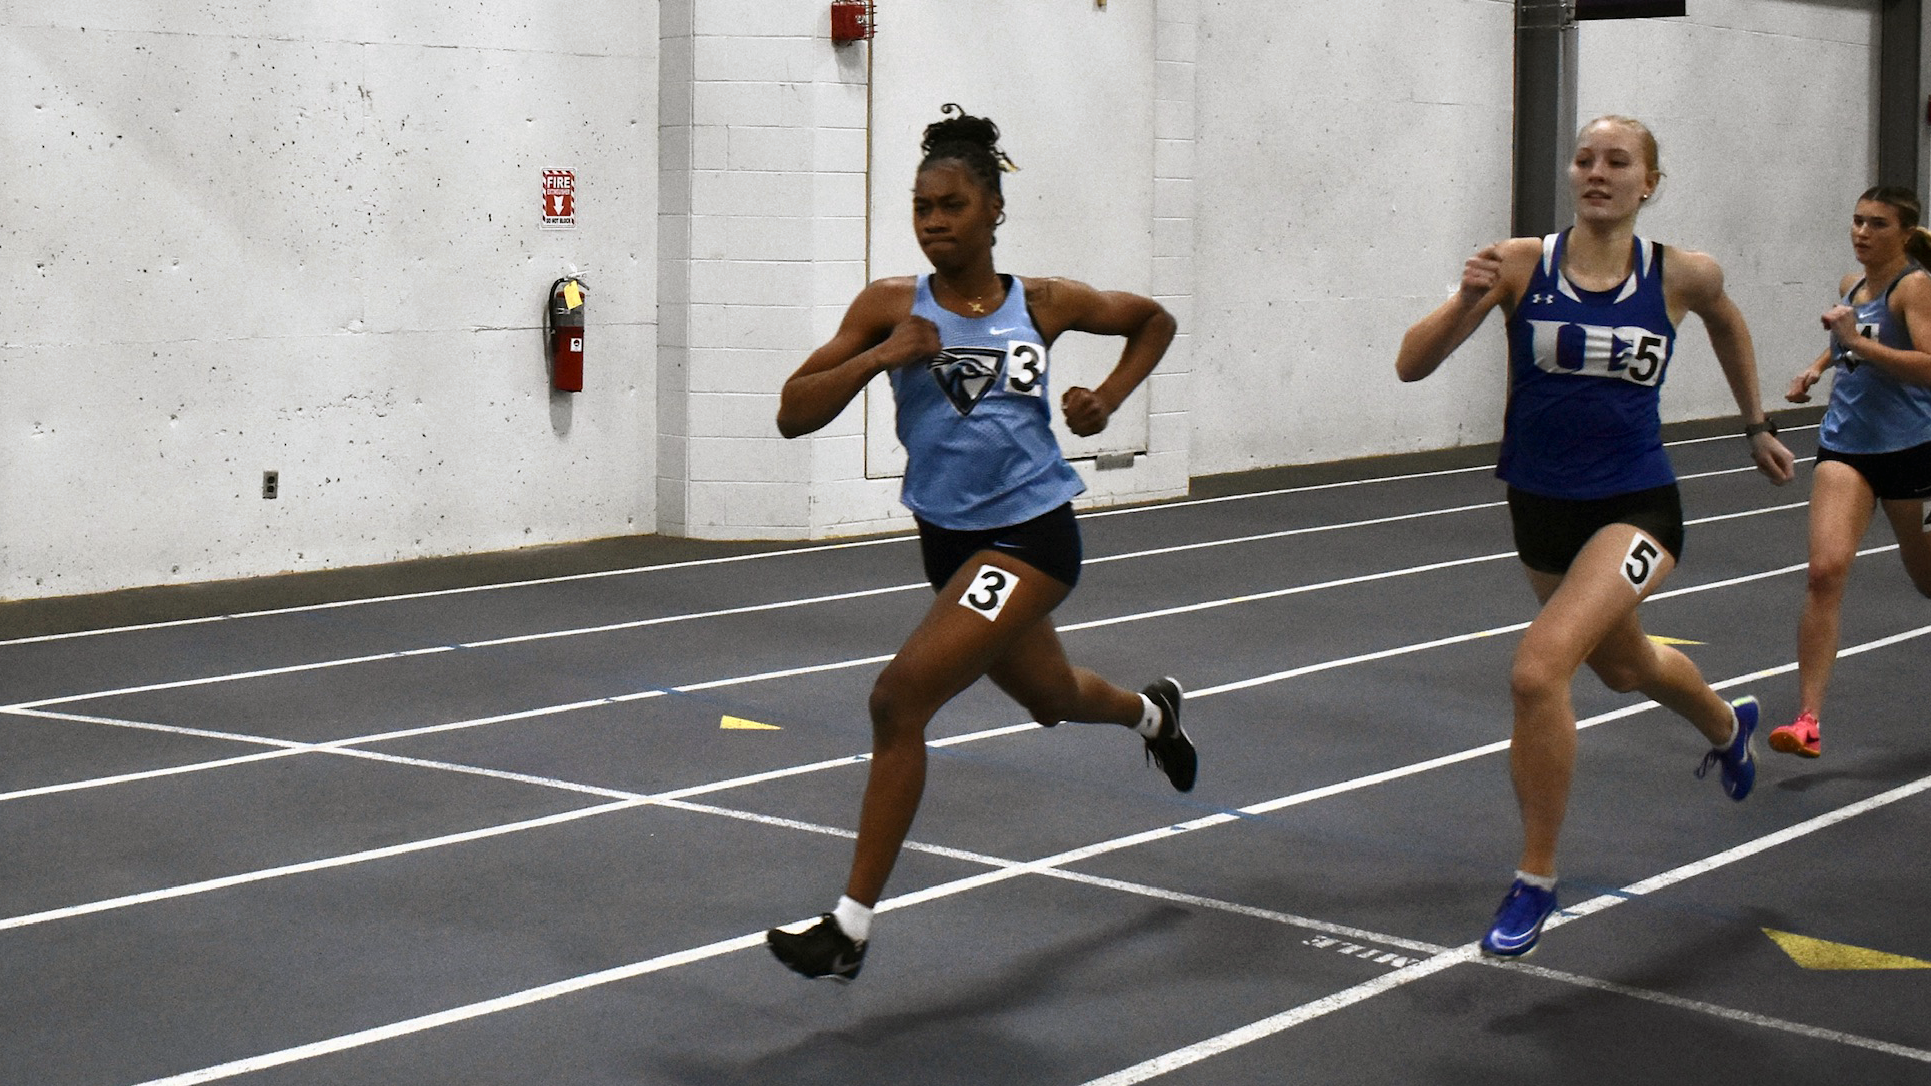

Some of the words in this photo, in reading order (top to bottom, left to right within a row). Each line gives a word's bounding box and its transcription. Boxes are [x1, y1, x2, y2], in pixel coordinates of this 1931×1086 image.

[547, 176, 571, 189] FIRE
[1010, 345, 1039, 392] 3
[1629, 336, 1661, 382] 5
[1626, 540, 1657, 584] 5
[968, 571, 1006, 611] 3
